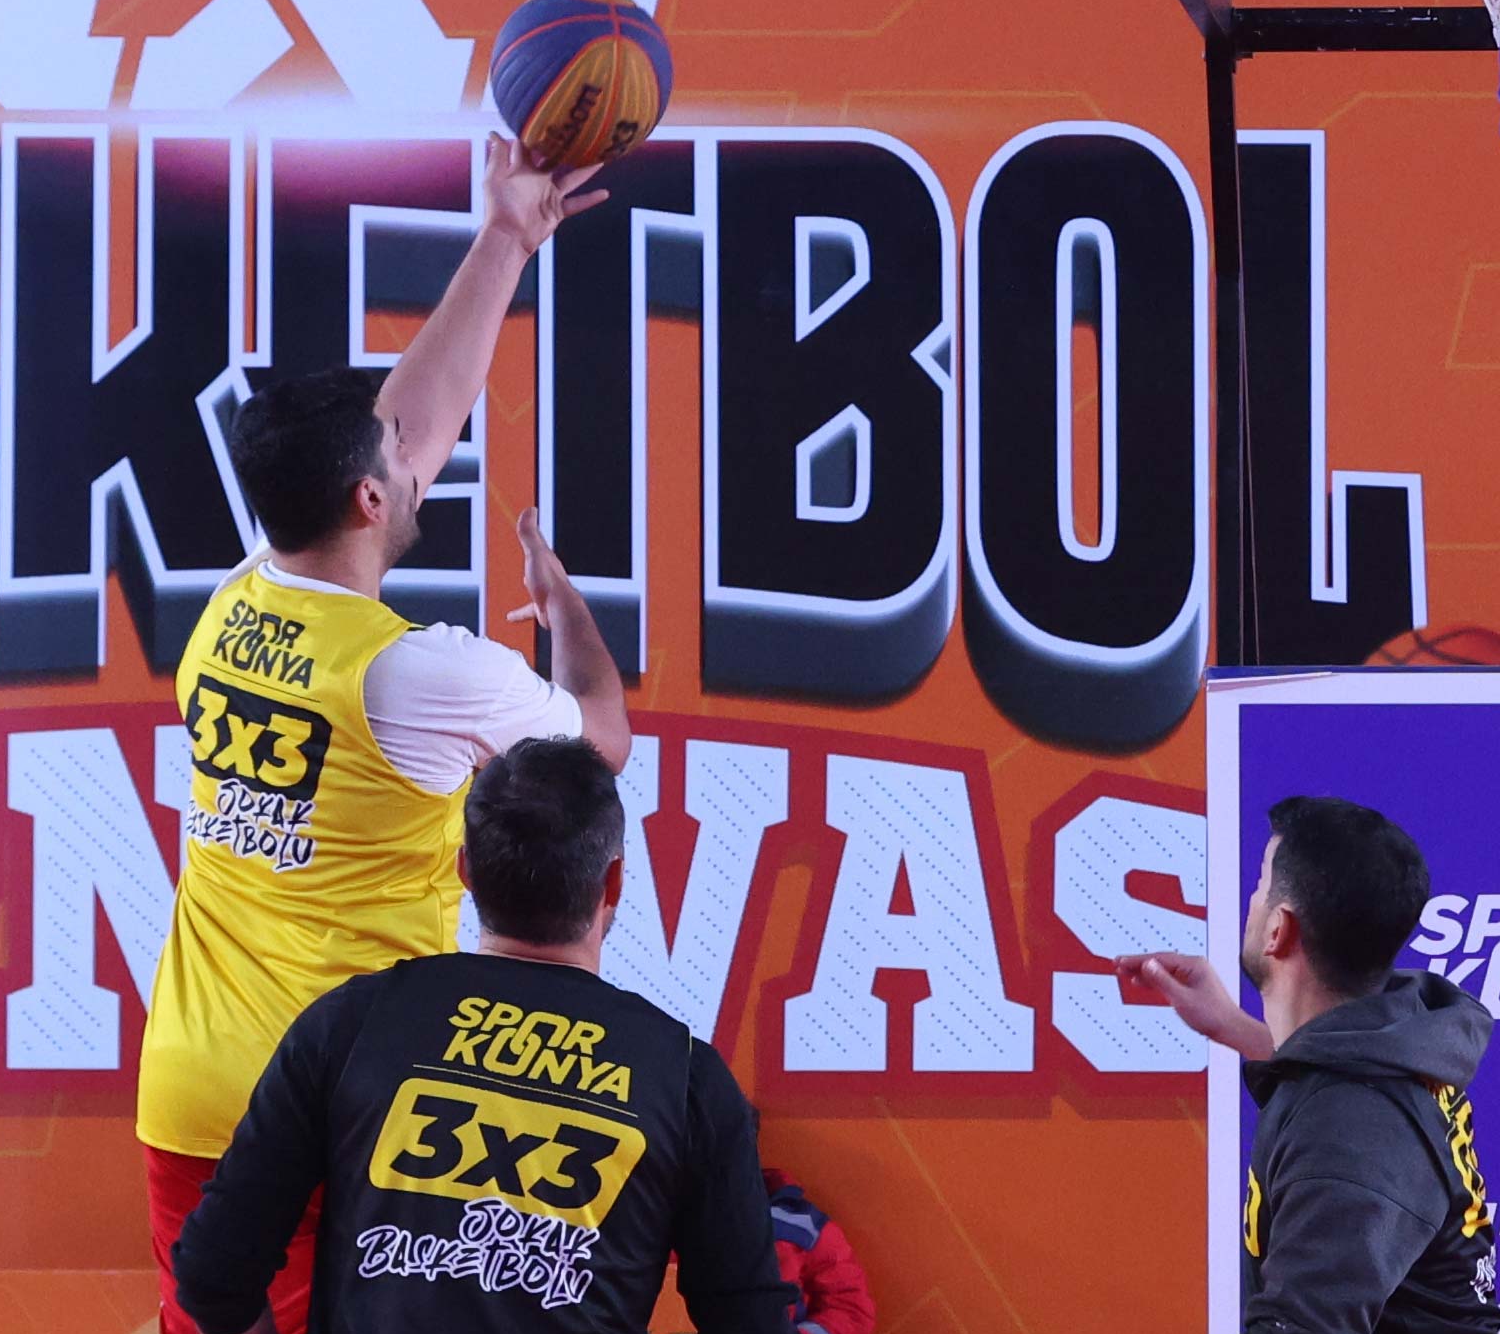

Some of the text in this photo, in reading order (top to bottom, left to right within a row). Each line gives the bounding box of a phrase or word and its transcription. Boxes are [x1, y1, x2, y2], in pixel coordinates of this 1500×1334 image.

[225, 599, 306, 651] SPOR
[213, 630, 315, 689] KONYA
[448, 997, 606, 1057] SPOR
[442, 1028, 633, 1103] KONYA
